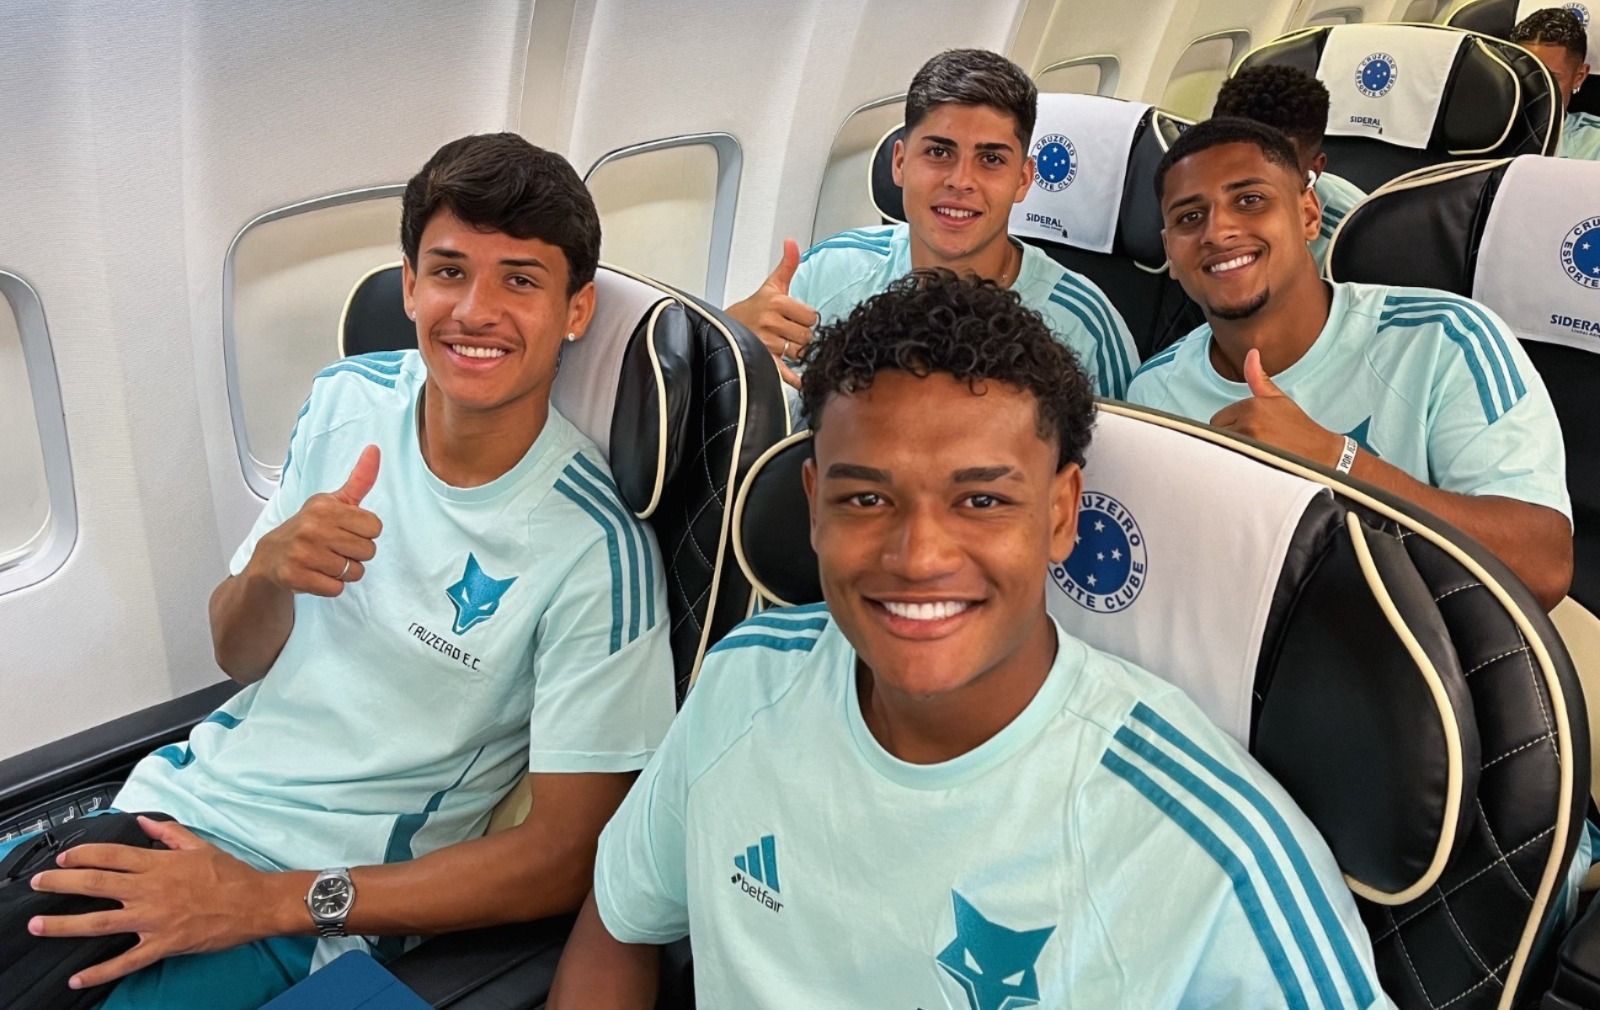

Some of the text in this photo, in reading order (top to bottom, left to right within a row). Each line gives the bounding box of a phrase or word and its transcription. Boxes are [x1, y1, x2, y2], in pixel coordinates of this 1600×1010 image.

[1036, 135, 1075, 156] CRUZEIRO
[1057, 162, 1077, 189] CLUBE
[1026, 212, 1063, 228] SIDERAL
[1562, 240, 1599, 288] ESPORTE
[1550, 313, 1600, 335] SIDERA
[1078, 495, 1141, 547] UZEIRO
[1053, 560, 1144, 610] ORTE CLUBE
[741, 876, 784, 913] betfair
